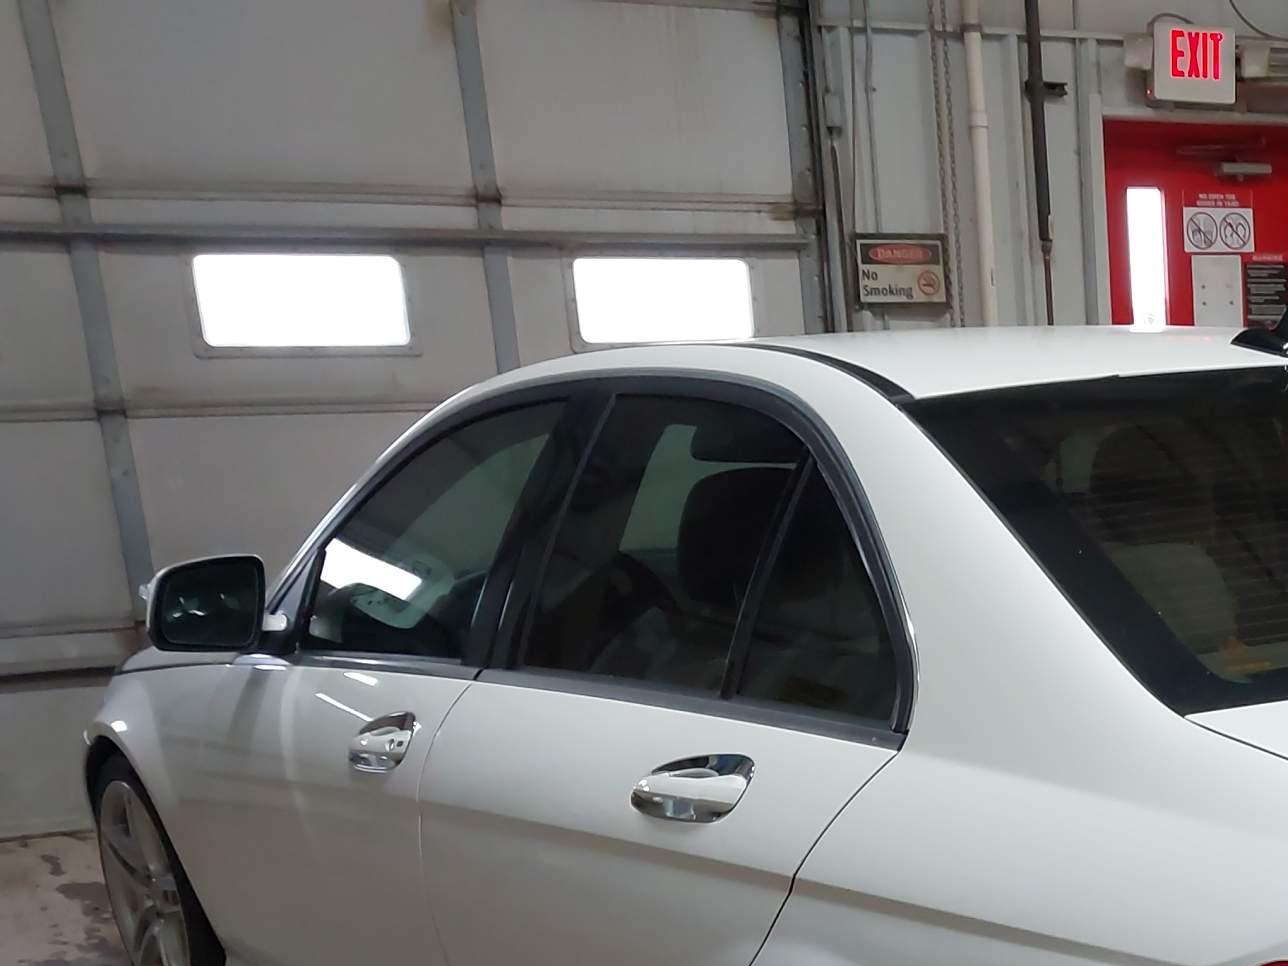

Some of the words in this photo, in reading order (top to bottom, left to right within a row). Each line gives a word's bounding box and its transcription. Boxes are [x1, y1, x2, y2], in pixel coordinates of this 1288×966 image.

[1171, 29, 1224, 80] EXIT
[862, 268, 878, 281] No
[863, 284, 914, 301] Smoking
